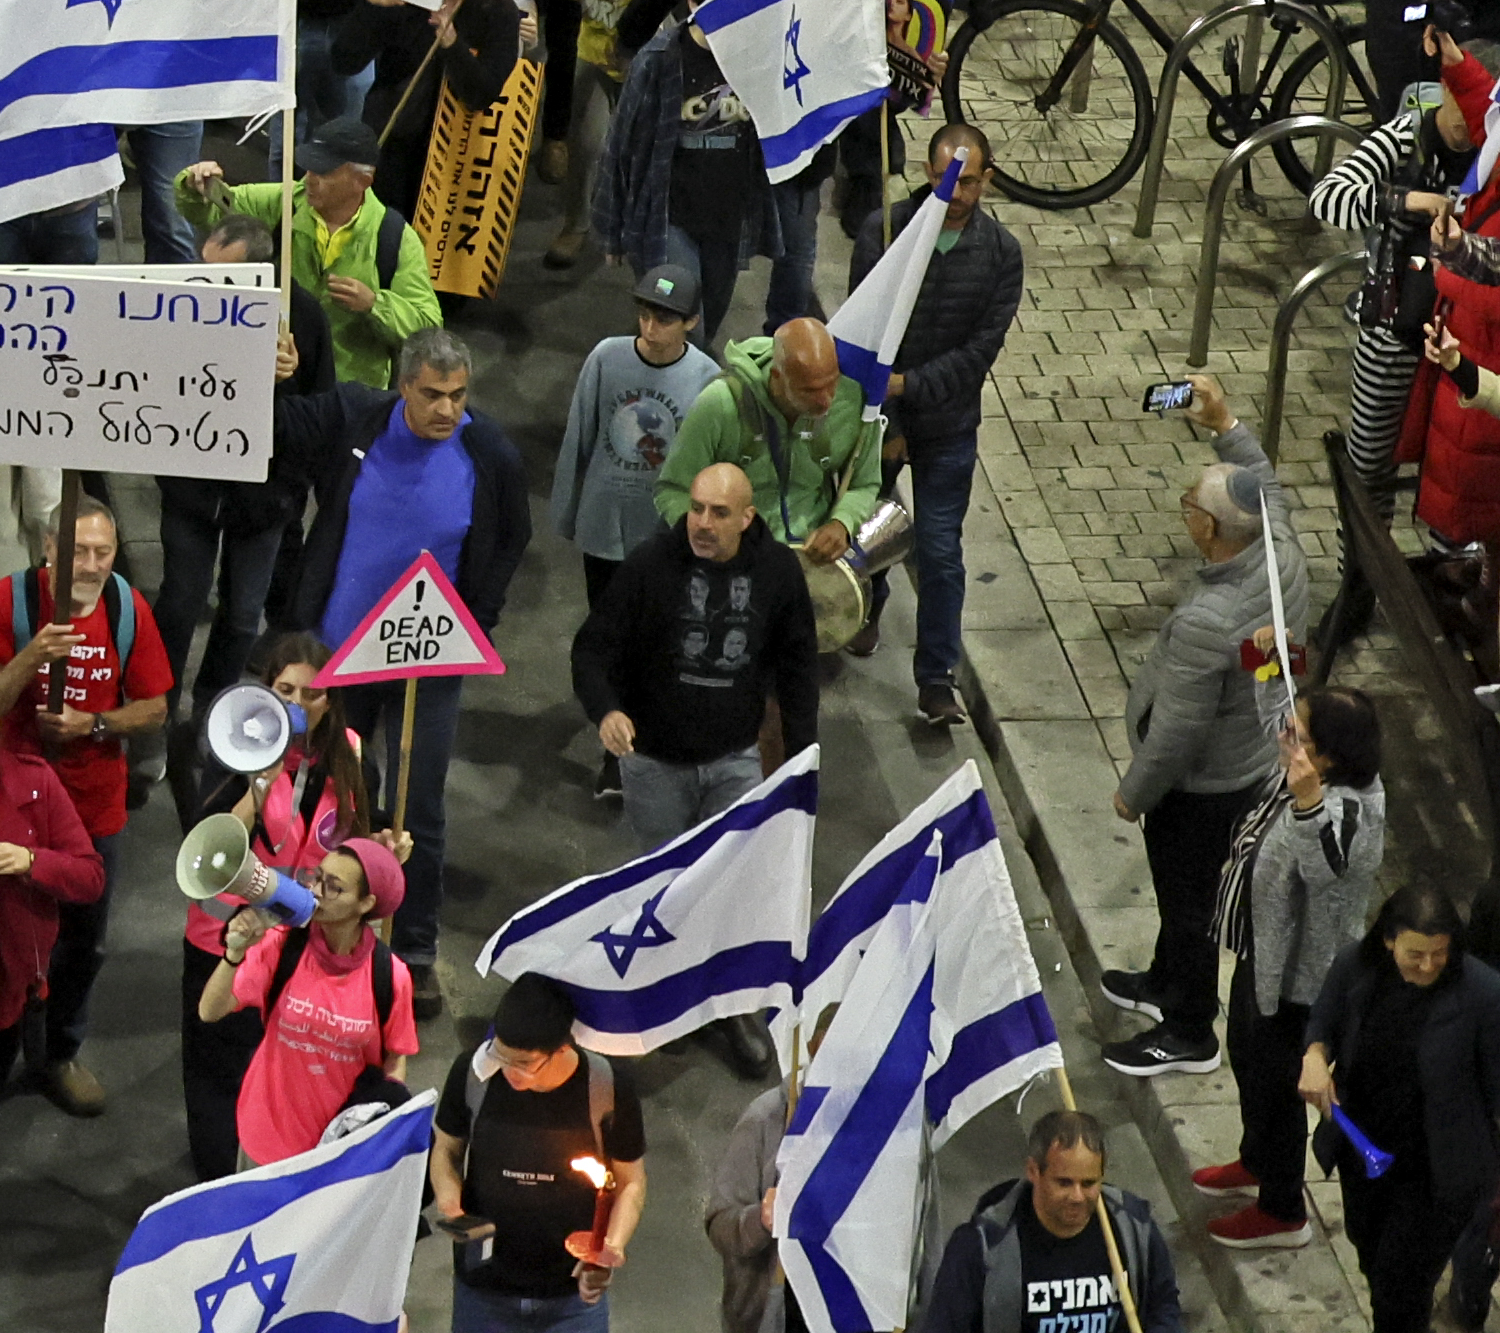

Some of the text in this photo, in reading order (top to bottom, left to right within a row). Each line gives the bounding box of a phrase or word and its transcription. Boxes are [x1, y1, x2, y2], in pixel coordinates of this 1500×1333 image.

[118, 287, 268, 329] אנחנו
[177, 366, 240, 400] עליו
[379, 613, 454, 643] DEAD
[385, 637, 442, 666] END
